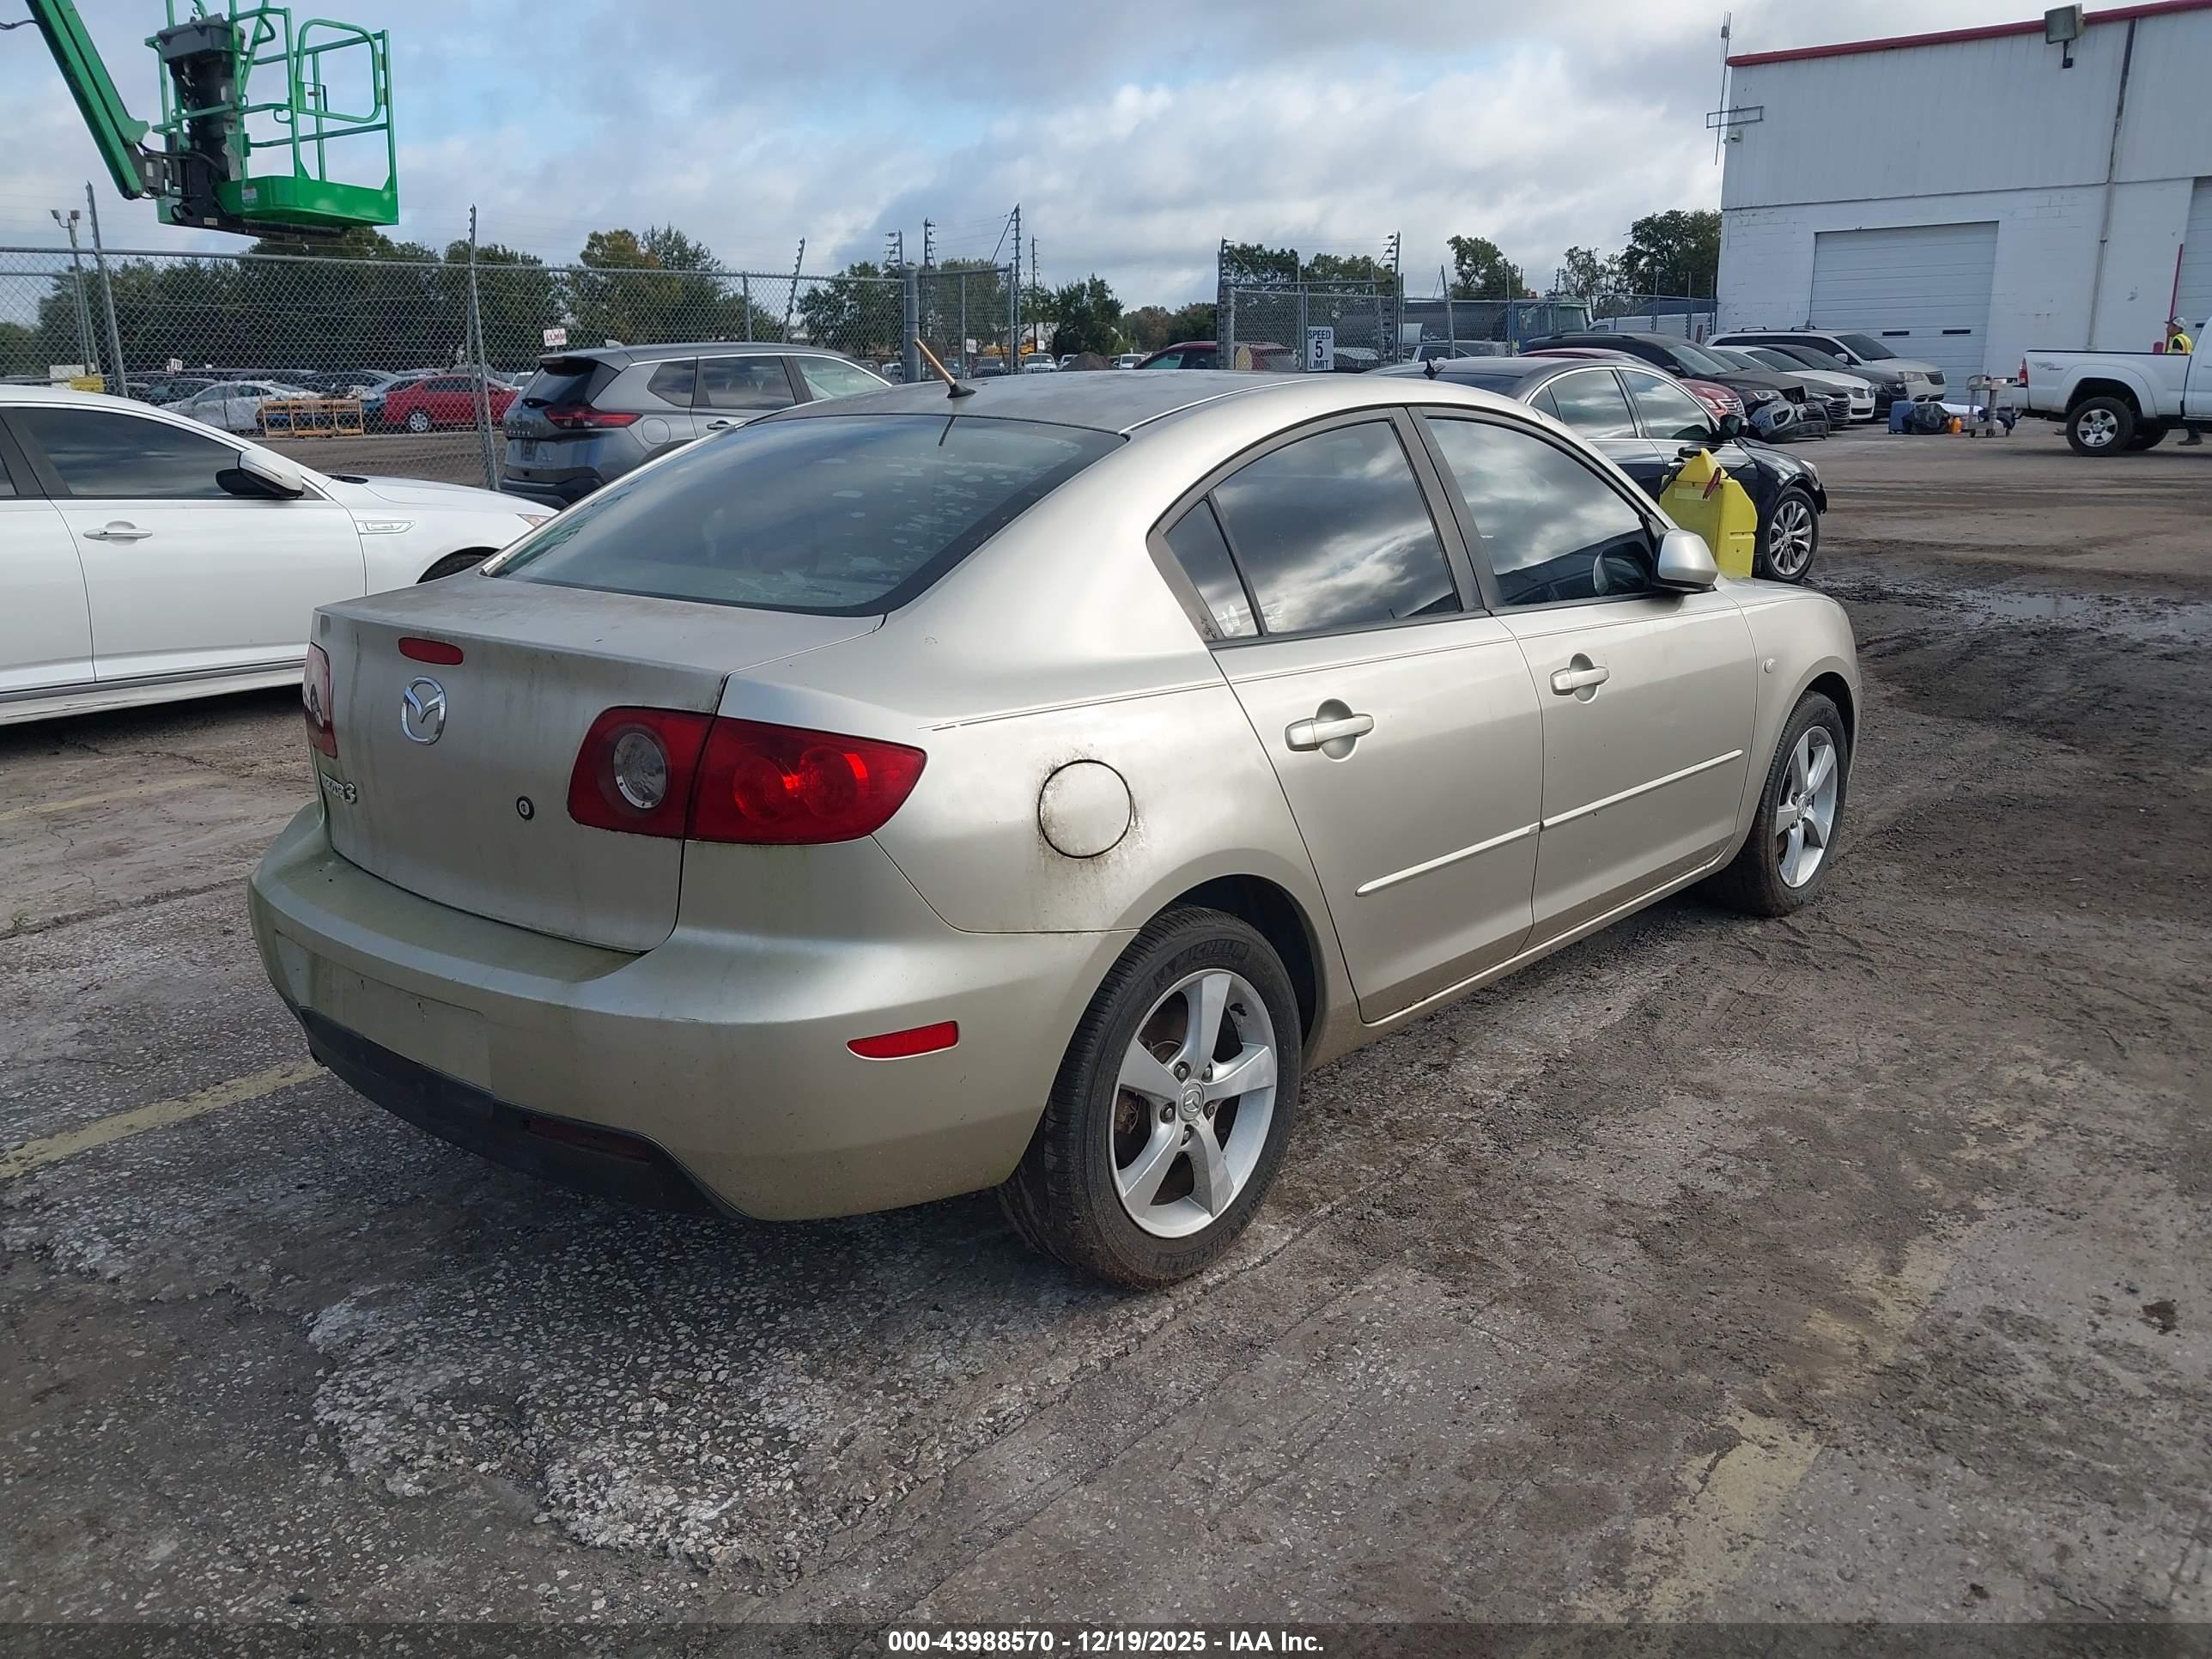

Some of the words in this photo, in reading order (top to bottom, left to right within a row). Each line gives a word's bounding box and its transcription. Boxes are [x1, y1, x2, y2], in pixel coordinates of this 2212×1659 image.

[1308, 330, 1331, 340] SPEED
[1315, 340, 1323, 359] 5
[1309, 359, 1329, 369] LIMIT
